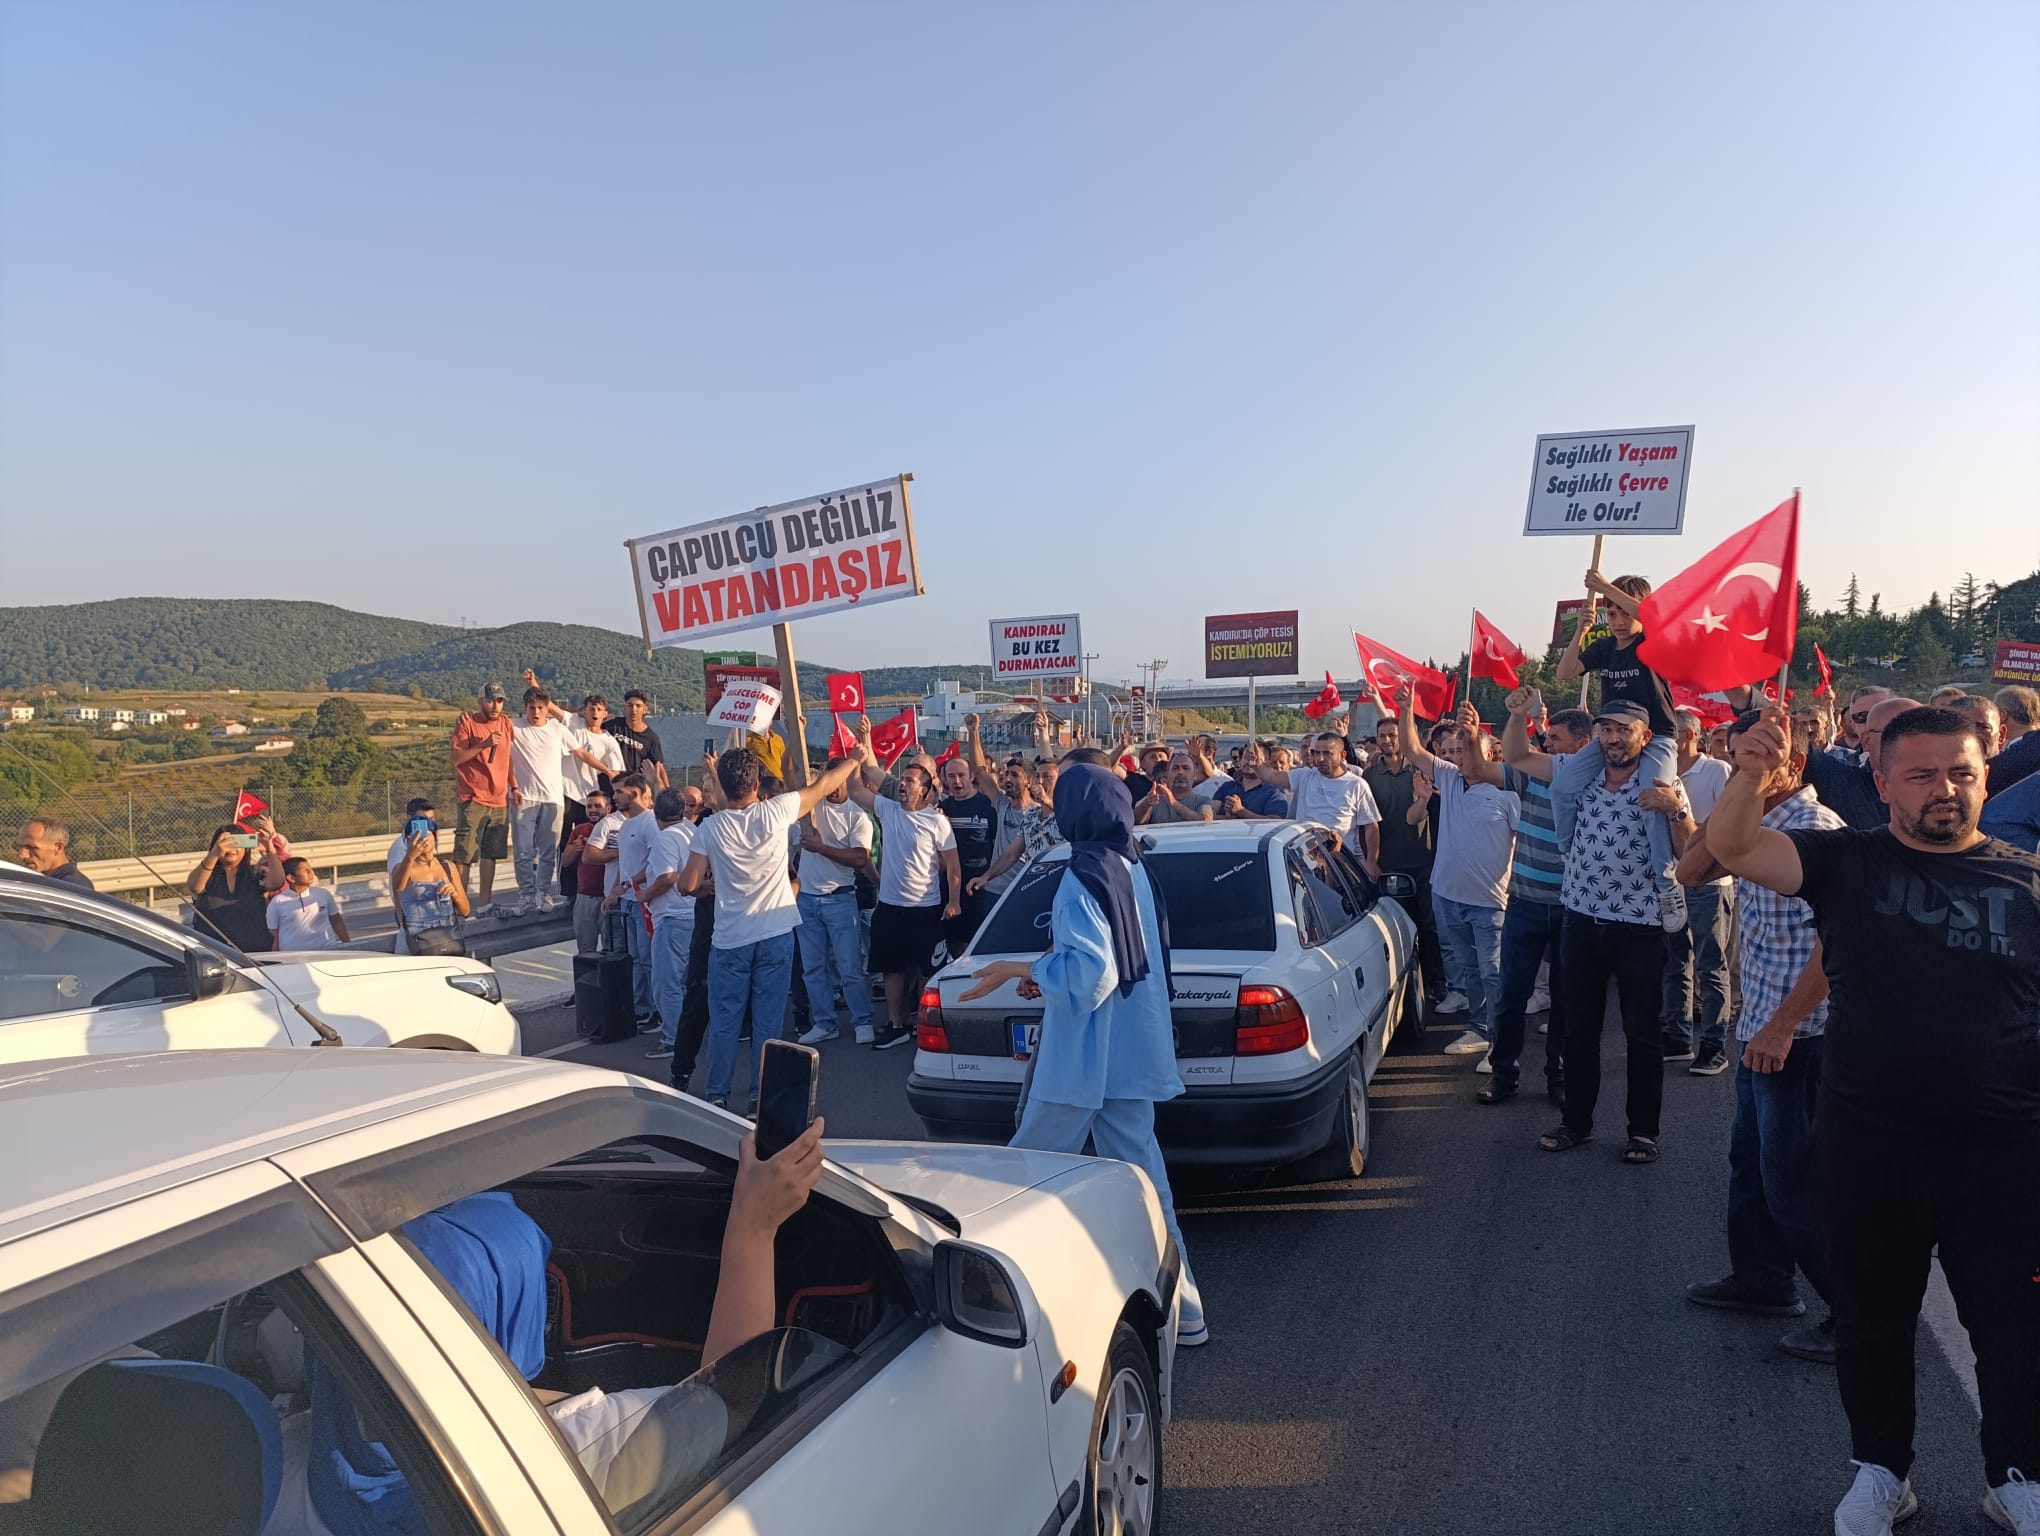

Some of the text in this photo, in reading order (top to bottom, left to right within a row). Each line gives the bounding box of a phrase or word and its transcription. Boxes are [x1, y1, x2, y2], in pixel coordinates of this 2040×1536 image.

[1546, 443, 1678, 469] Sağlıklı Yaşam
[1546, 472, 1669, 498] Sağlıklı Çevre
[1564, 501, 1641, 521] ile Olur!
[647, 488, 896, 589] ÇAPULCU DEĞİLİZ
[652, 539, 907, 633] VATANDAŞIZ
[1004, 623, 1066, 639] KANDIRALI
[1209, 624, 1294, 641] KANDIRA'DA ÇÖP TESİSİ
[1012, 639, 1060, 656] BU KEZ
[1211, 641, 1292, 661] İSTEMİYORUZ!
[2009, 649, 2029, 658] ŞİMDİ
[998, 655, 1076, 672] DURMAYACAK
[2002, 659, 2034, 670] OLMAYAN
[1994, 669, 2030, 681] KÖYÜMÜZE
[734, 698, 751, 711] ÇÖP
[719, 710, 750, 723] DÖKME
[1874, 870, 2015, 936] JUST
[1946, 928, 2016, 957] DO IT.
[1015, 1040, 1025, 1048] TR
[957, 1063, 982, 1071] OPEL
[1186, 1066, 1225, 1074] ASTRA
